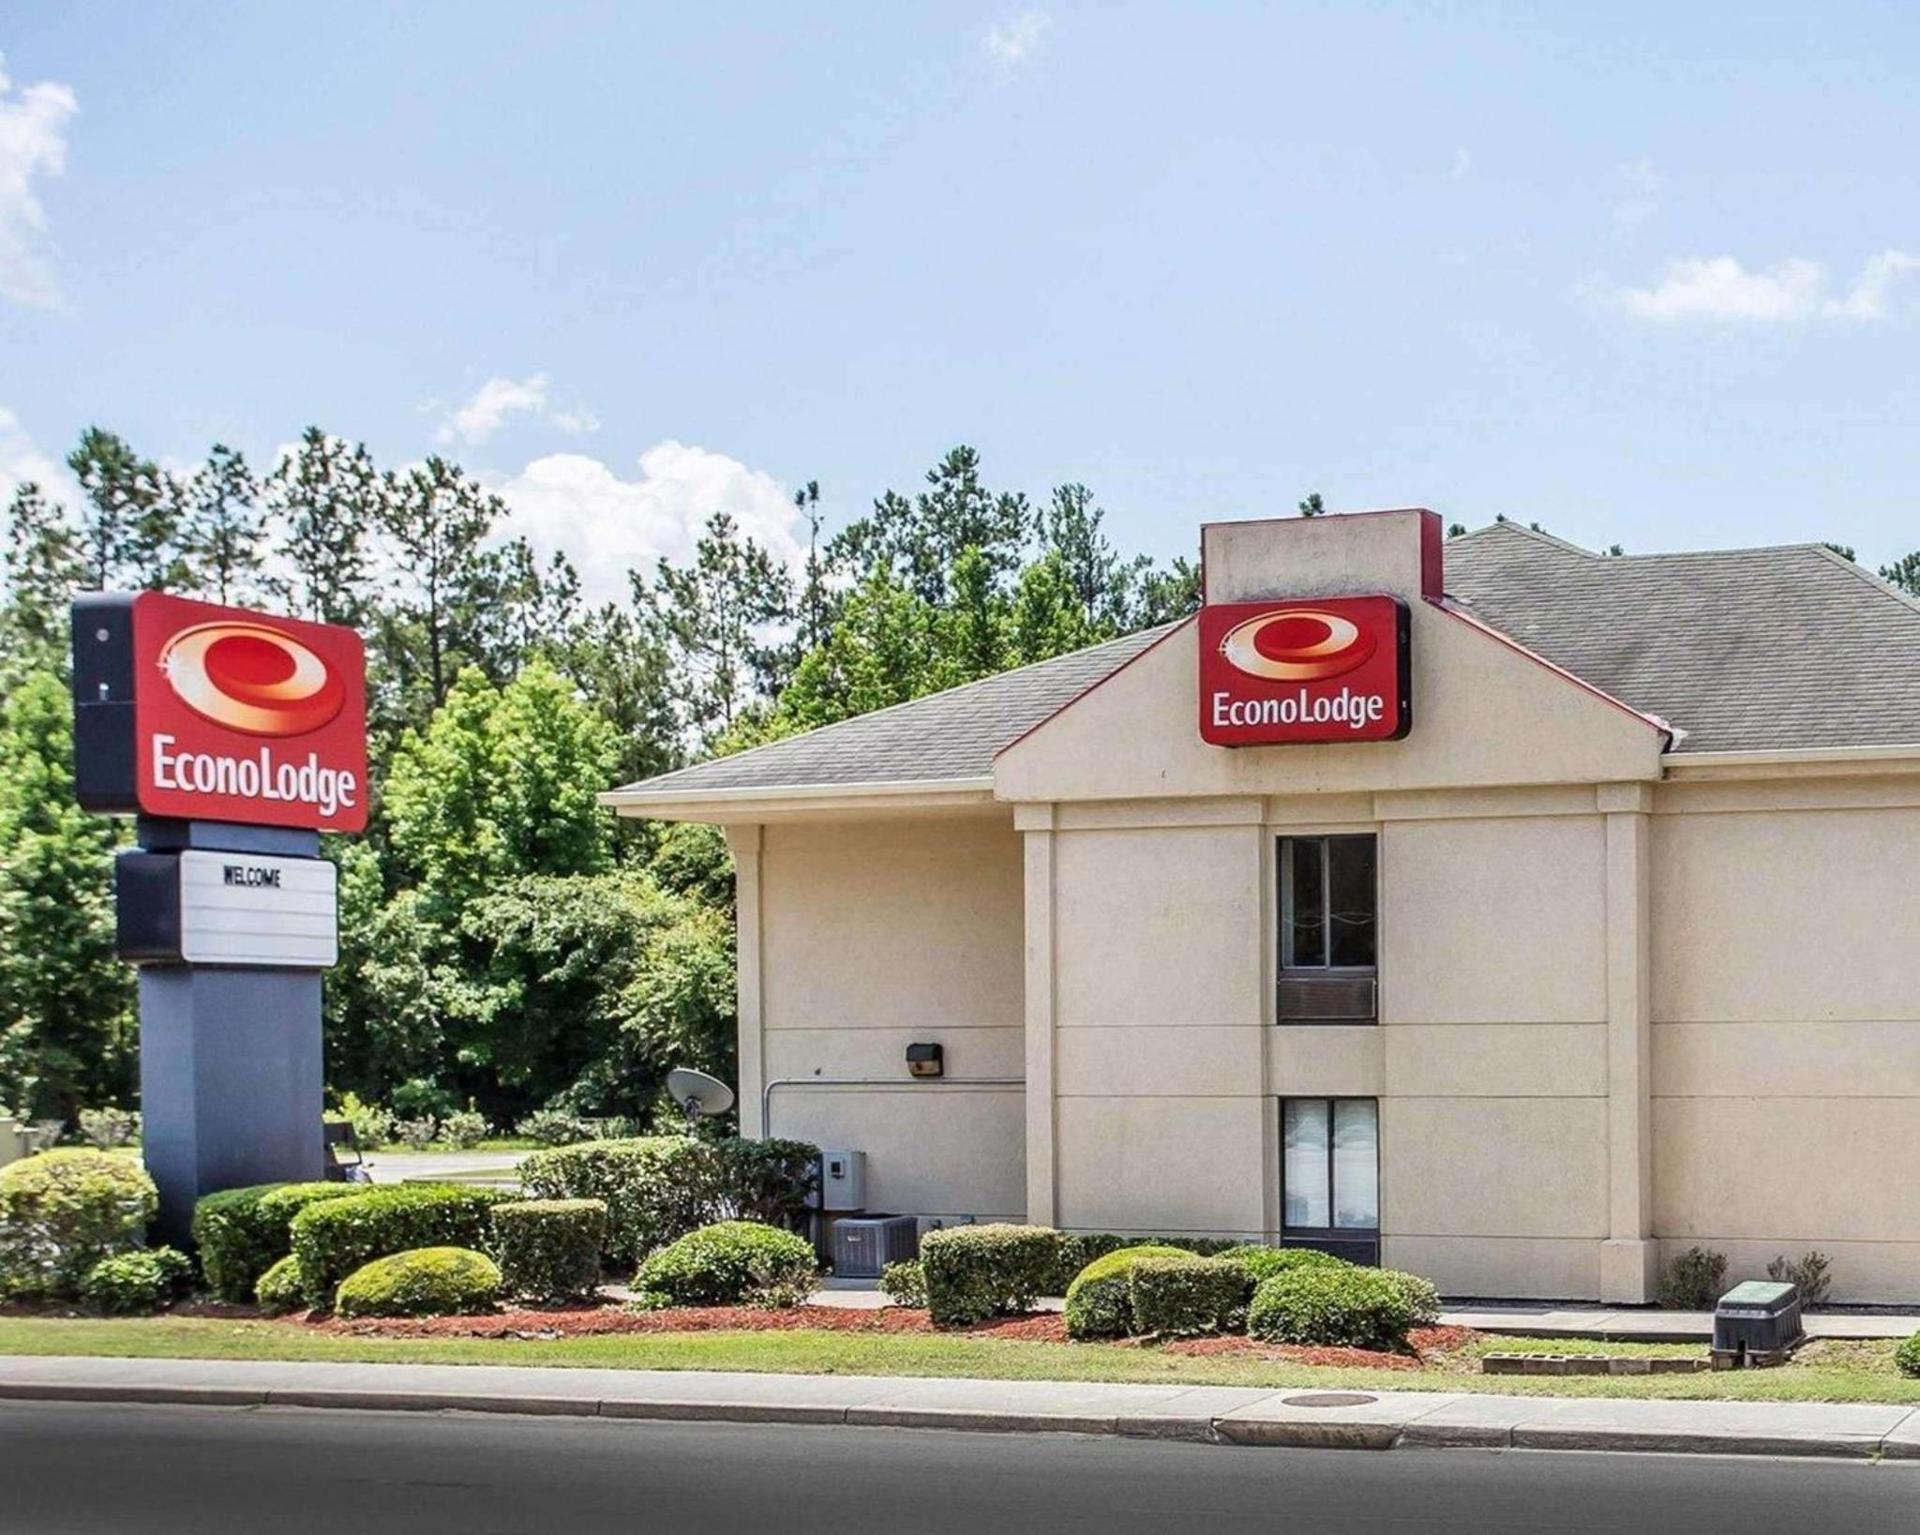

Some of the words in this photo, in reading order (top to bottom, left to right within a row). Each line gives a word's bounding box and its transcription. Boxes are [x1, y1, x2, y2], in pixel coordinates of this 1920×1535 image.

[1212, 687, 1384, 729] EconoLodge
[151, 733, 356, 817] EconoLodge
[223, 865, 281, 888] WELCOME
